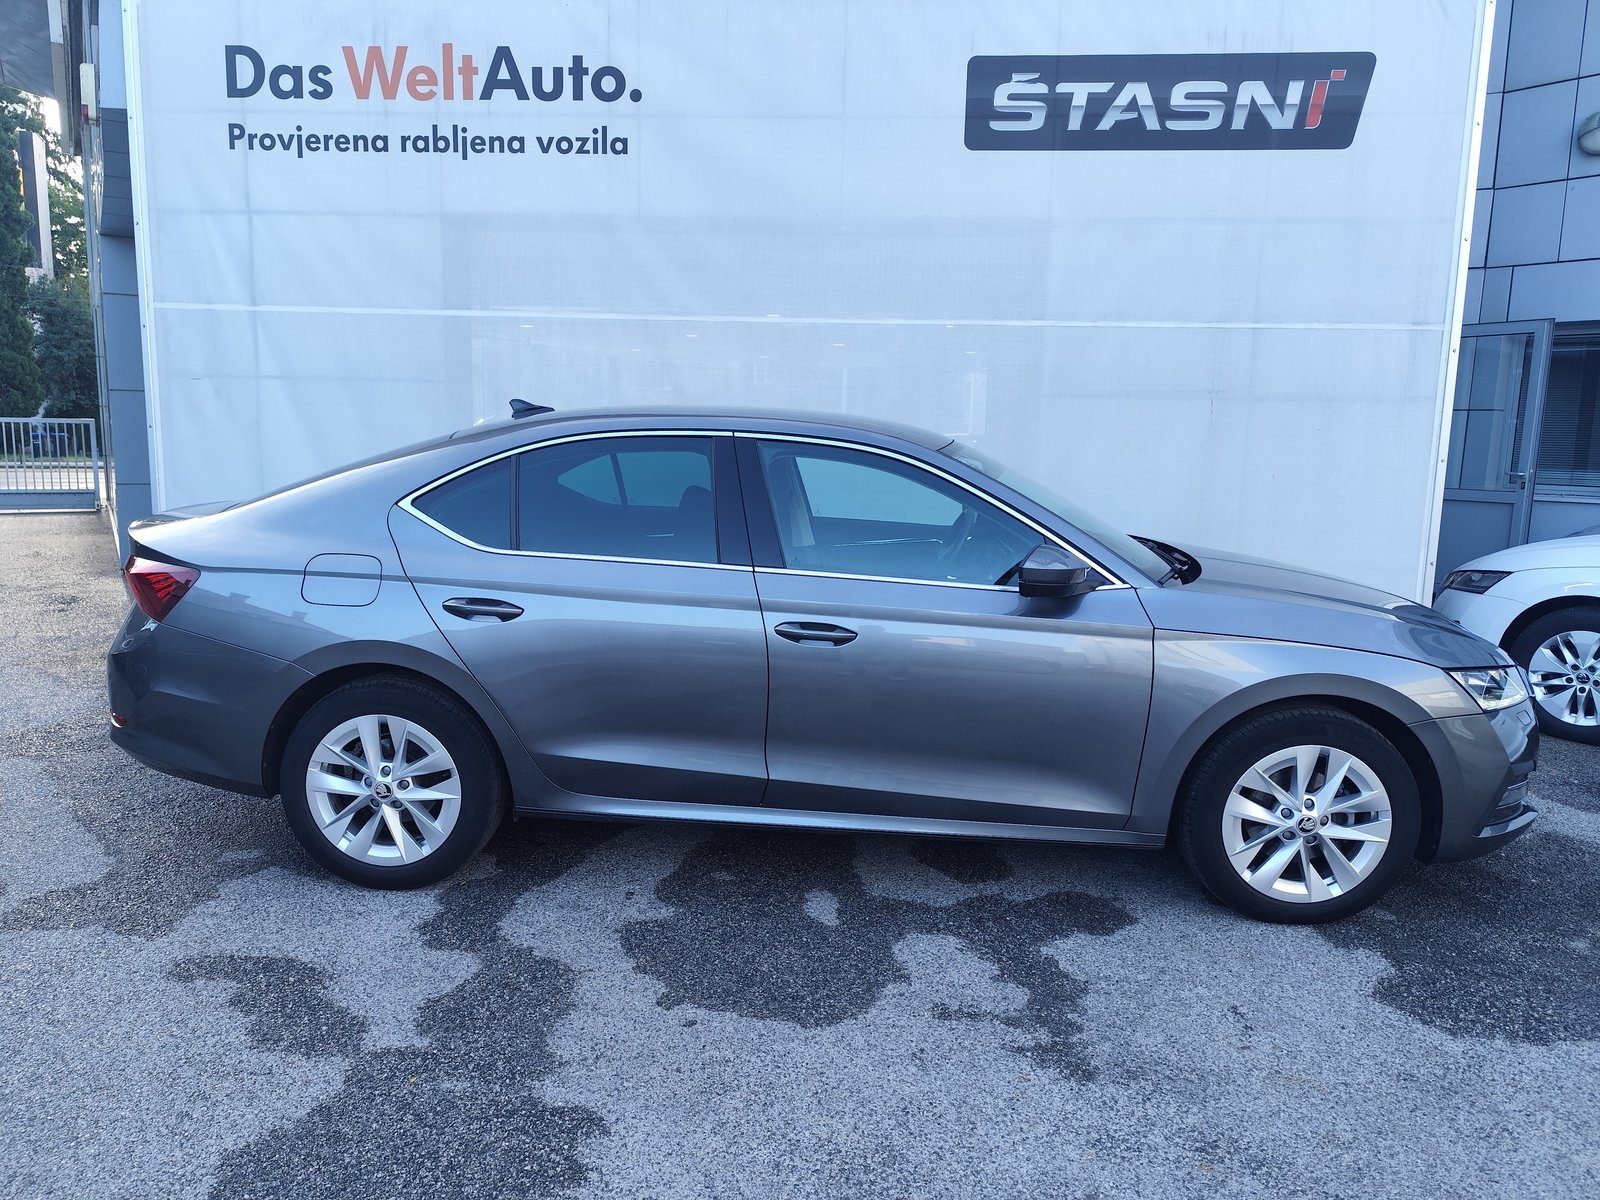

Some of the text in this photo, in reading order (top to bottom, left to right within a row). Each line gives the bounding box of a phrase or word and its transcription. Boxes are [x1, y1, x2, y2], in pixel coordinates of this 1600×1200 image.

[224, 44, 334, 101] Das
[227, 122, 629, 161] Provjerena rabljena vozila
